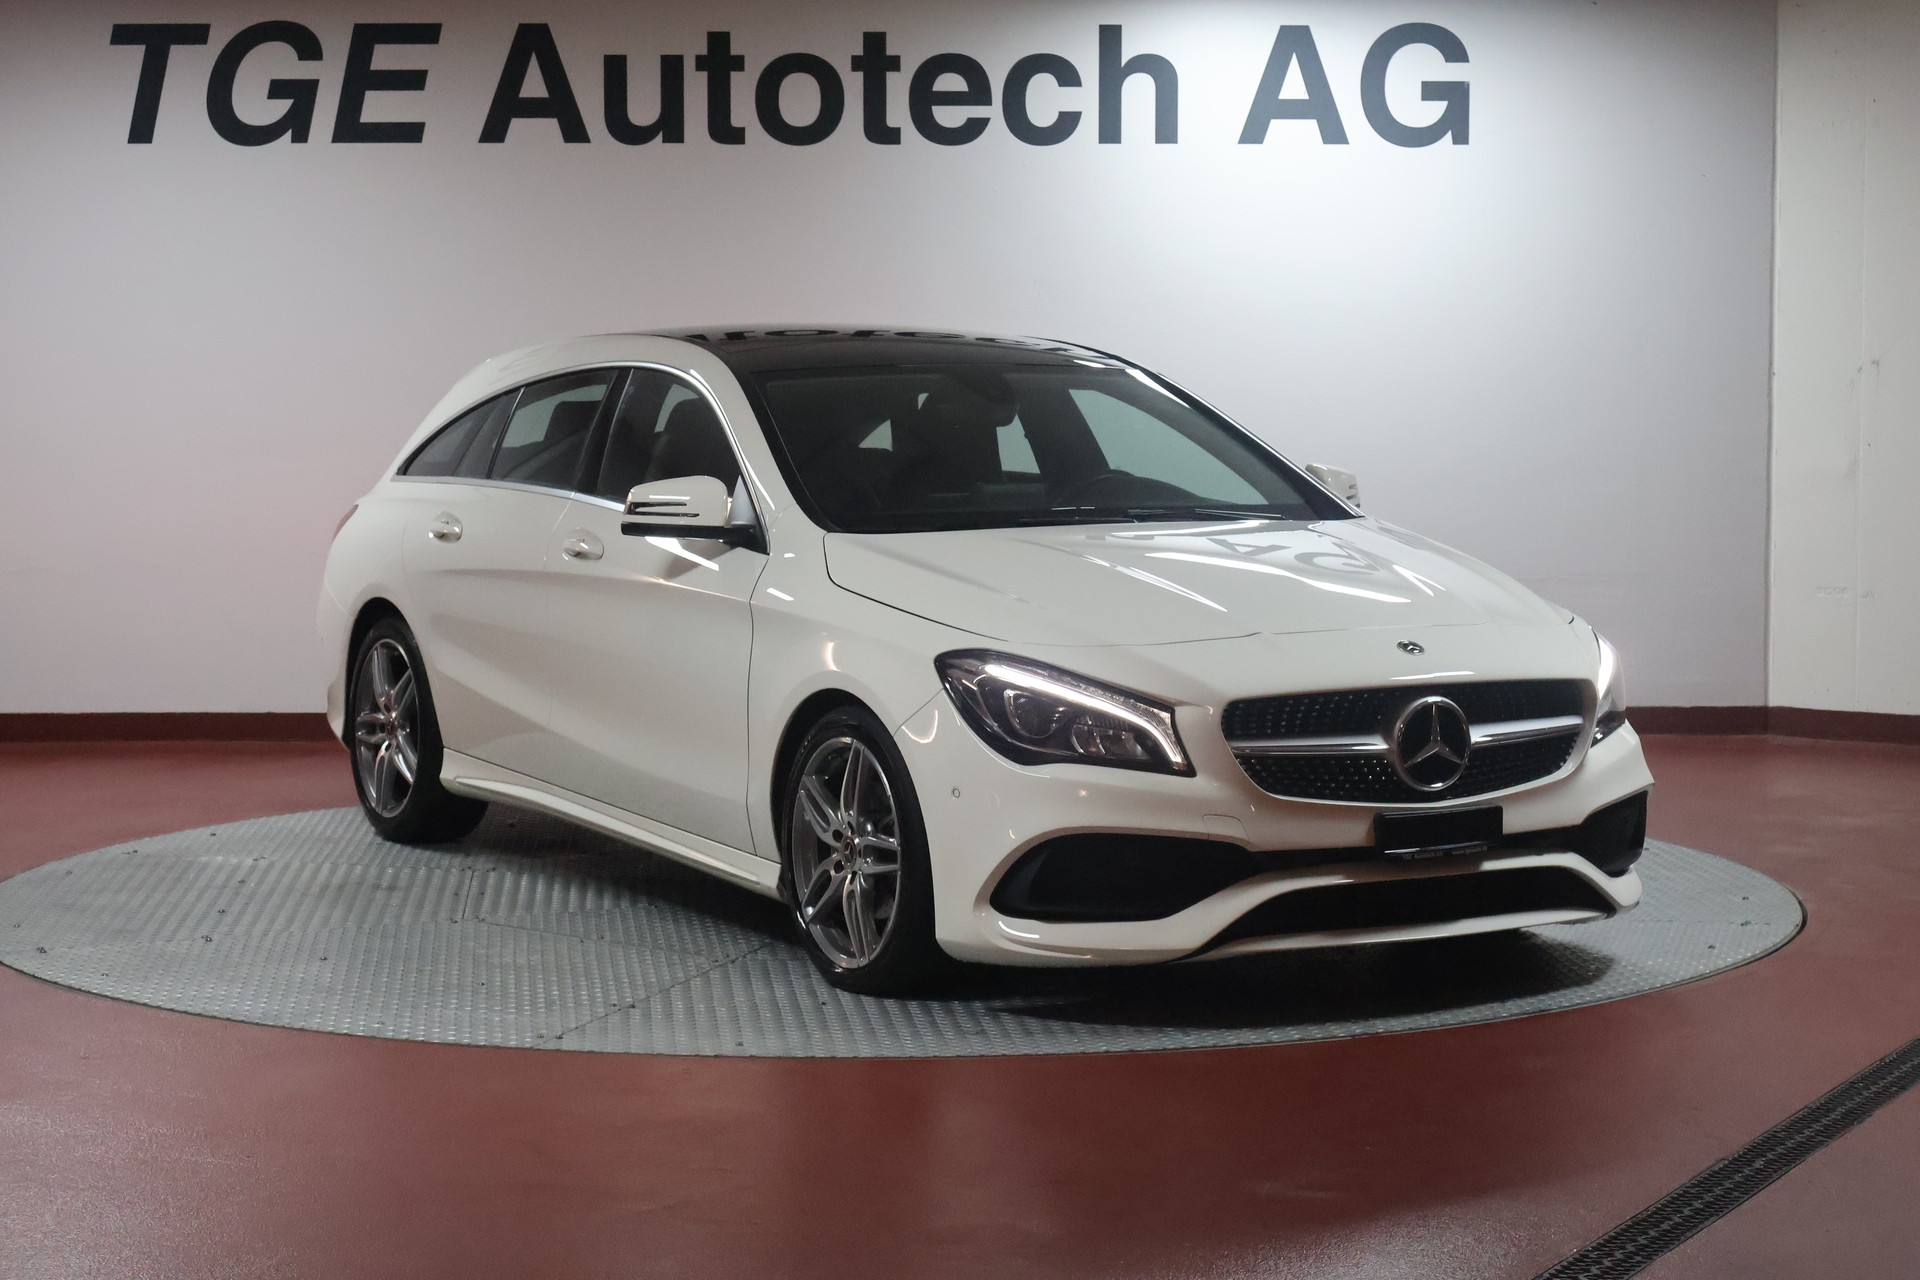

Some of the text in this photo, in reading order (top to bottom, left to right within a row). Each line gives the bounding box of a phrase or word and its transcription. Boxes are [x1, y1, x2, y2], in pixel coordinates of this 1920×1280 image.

[109, 20, 1470, 148] TGE Autotech AG
